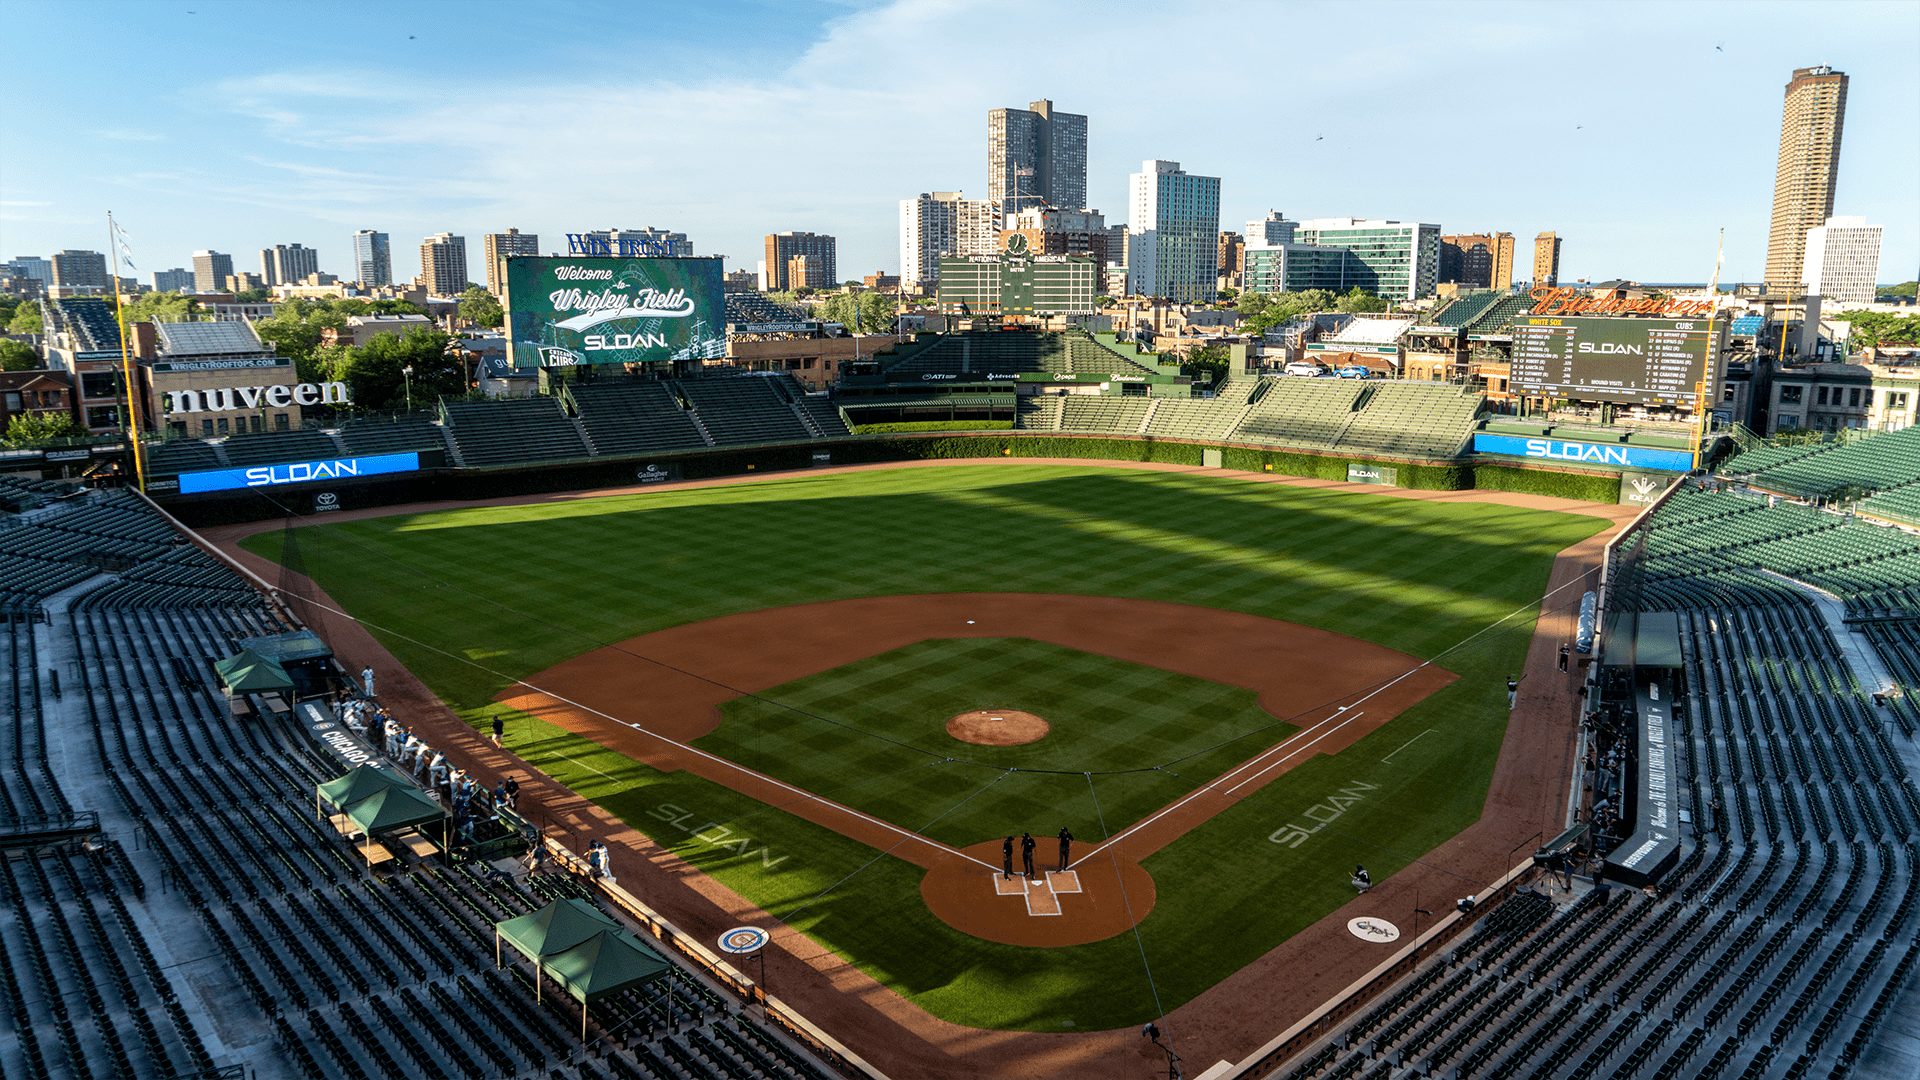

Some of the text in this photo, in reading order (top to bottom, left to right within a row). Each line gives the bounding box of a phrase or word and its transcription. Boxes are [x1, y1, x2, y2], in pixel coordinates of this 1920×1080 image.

[565, 233, 677, 256] WINTRUST
[1034, 255, 1067, 263] AMERICAN
[554, 265, 613, 281] Welcome
[549, 288, 687, 316] Wrigley Field
[1530, 286, 1714, 315] Budweiser
[1529, 318, 1549, 326] WHITE
[1675, 322, 1694, 330] CUBS
[584, 333, 665, 351] SLOAN
[1578, 342, 1641, 355] SLOAN
[169, 359, 276, 371] WRIGLEYROOFTOPS.COM
[1110, 373, 1146, 382] Budweiser
[167, 381, 350, 414] nuveen
[1525, 439, 1628, 465] SLOAN
[245, 459, 358, 486] SLOAN
[637, 471, 668, 479] Gallagher
[1348, 469, 1379, 479] SLOAN
[1629, 493, 1656, 504] IDEAL
[321, 731, 370, 764] CHICAGO
[1268, 780, 1379, 849] SLOAN
[645, 803, 790, 868] SLOAN
